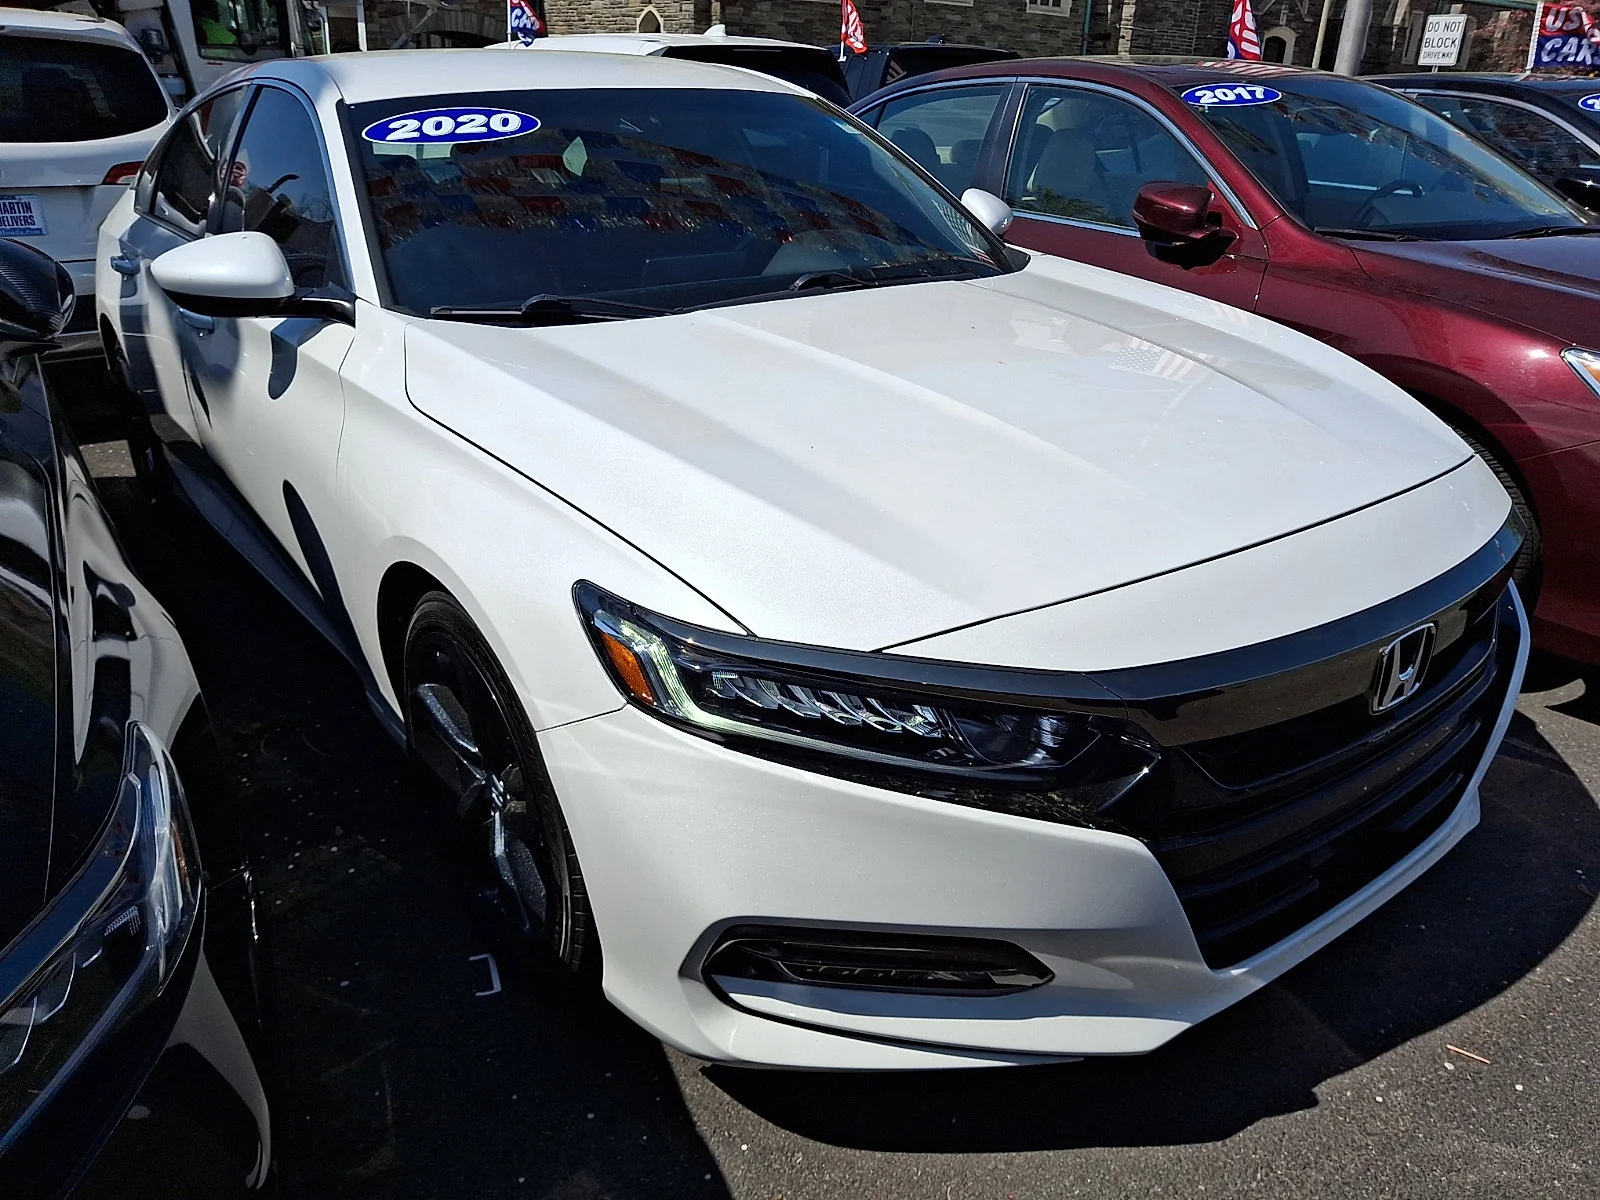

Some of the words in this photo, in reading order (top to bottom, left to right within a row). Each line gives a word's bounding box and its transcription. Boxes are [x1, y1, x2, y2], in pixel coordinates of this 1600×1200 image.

[1427, 21, 1440, 33] DO
[1443, 21, 1462, 33] NOT
[1424, 37, 1458, 48] BLOCK
[1423, 51, 1454, 59] DRIVEWAY
[1194, 86, 1265, 104] 2017
[385, 112, 522, 141] 2020
[0, 201, 33, 215] ARTIN
